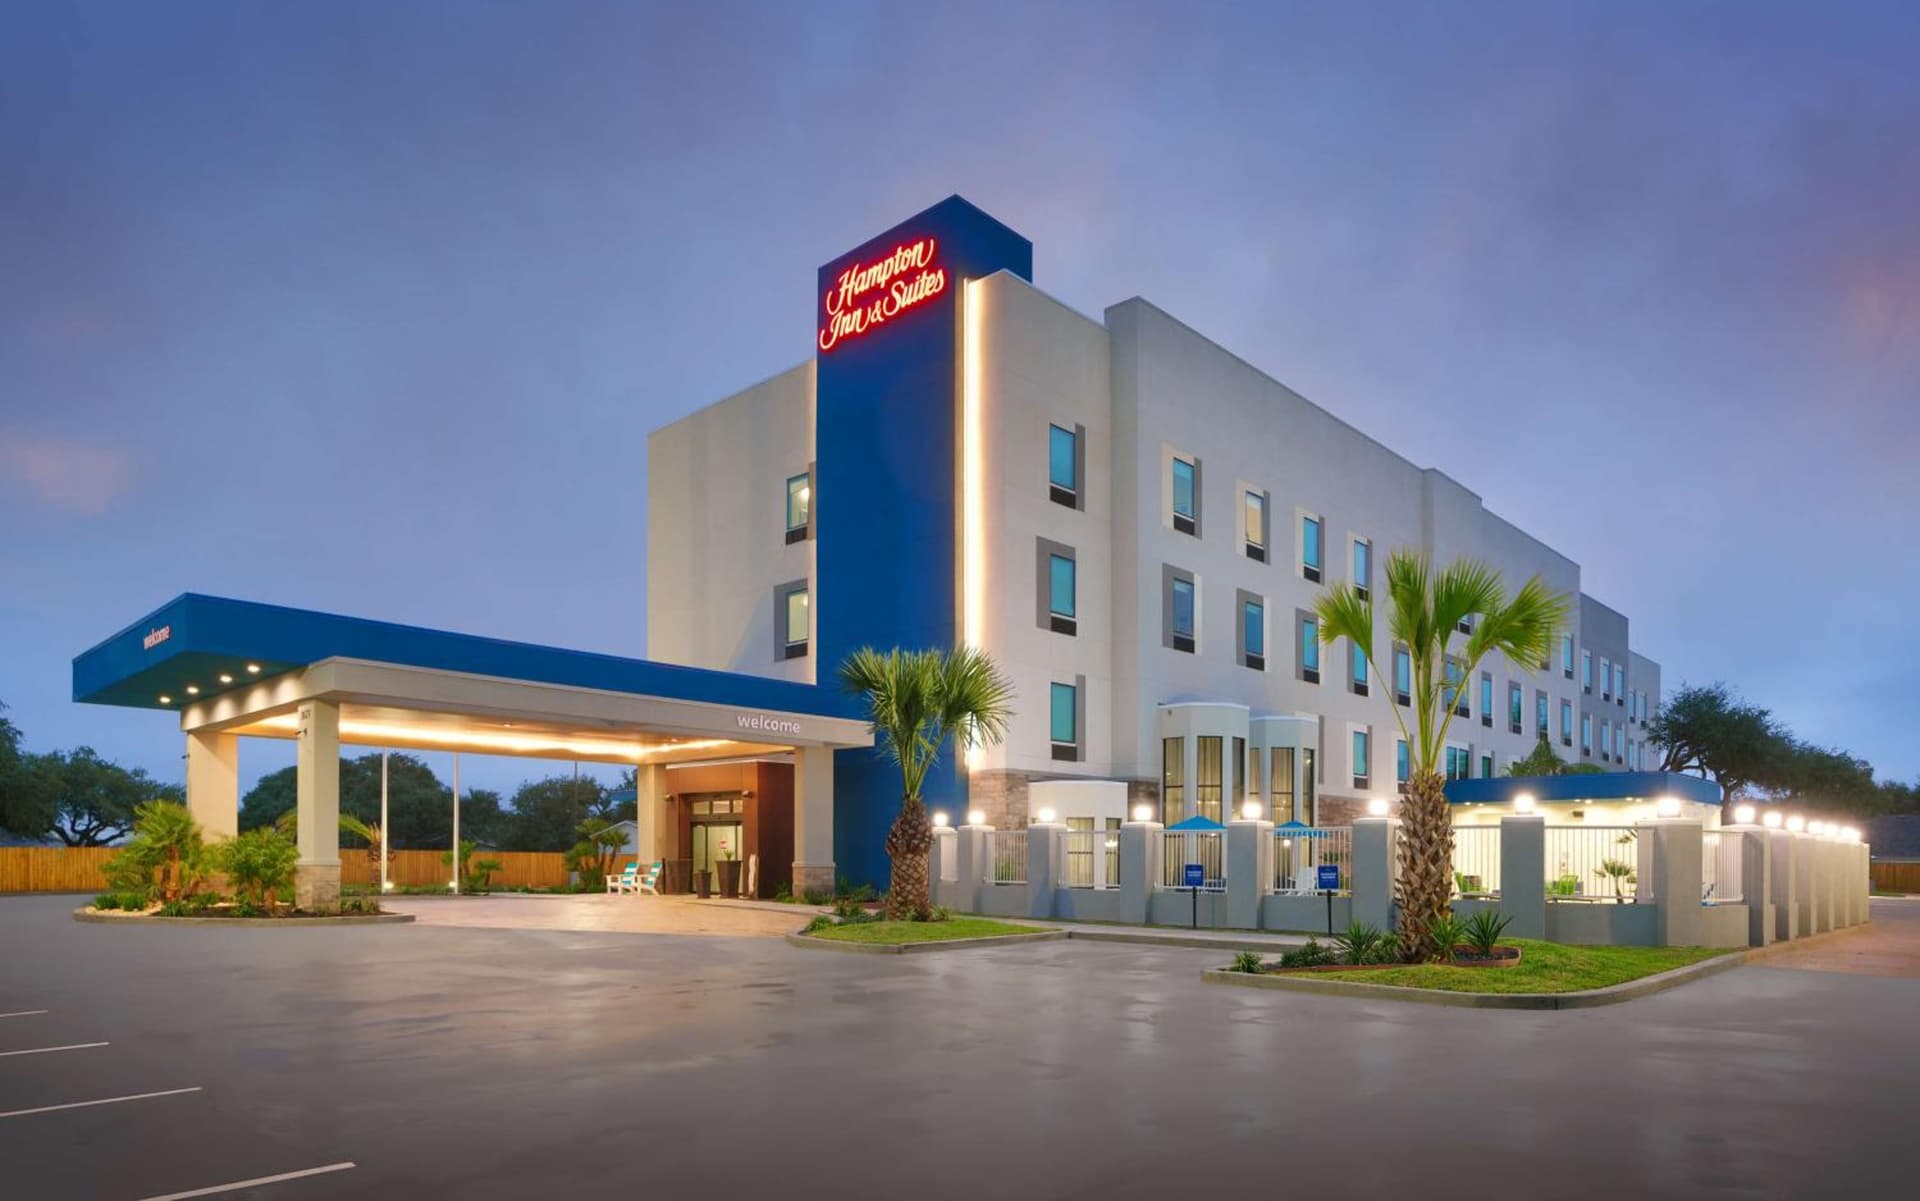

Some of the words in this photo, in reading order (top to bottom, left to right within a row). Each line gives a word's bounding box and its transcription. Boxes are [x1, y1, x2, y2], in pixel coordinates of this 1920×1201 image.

[826, 239, 935, 316] Hampton
[819, 306, 872, 350] Inn
[882, 268, 945, 316] Suites
[143, 625, 171, 650] welcome
[736, 715, 801, 734] welcome
